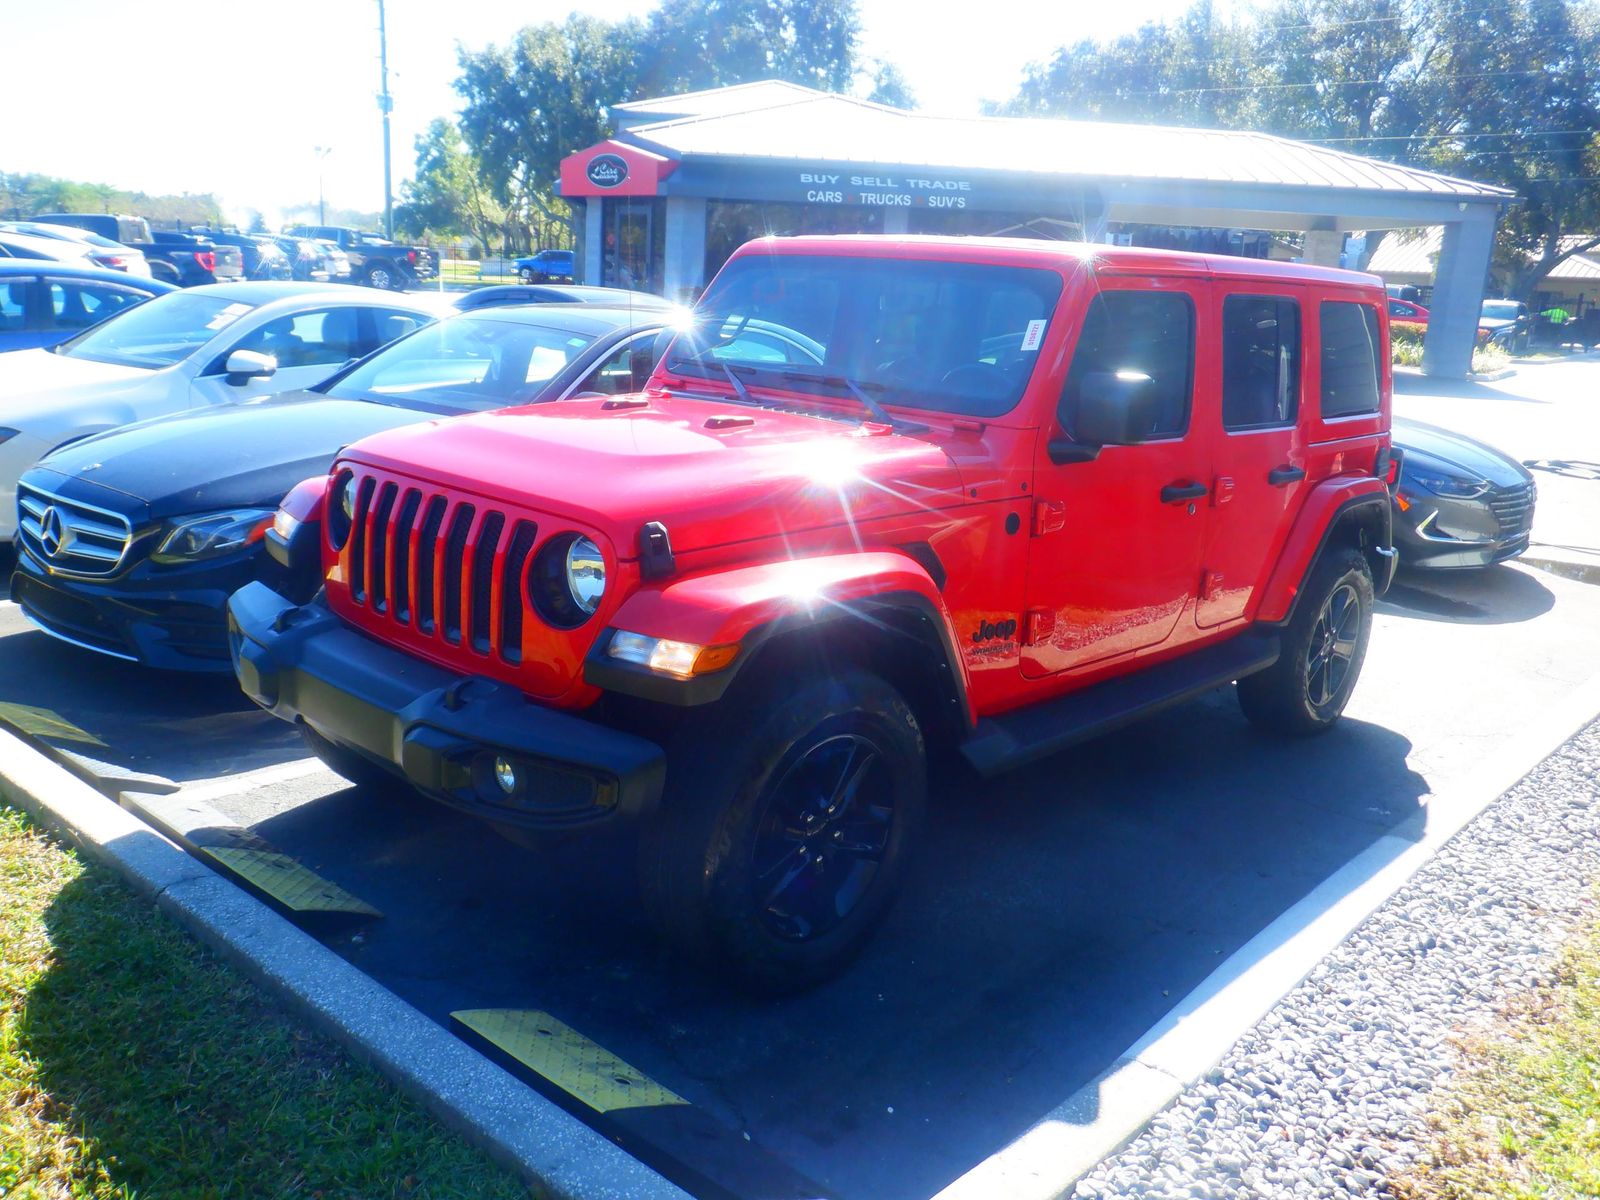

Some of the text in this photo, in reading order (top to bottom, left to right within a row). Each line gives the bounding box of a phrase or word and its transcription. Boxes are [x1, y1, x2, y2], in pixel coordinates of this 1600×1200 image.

[800, 173, 972, 191] BUY SELL TRADE
[807, 190, 966, 208] CARS TRUCKS SUV'S
[972, 618, 1017, 643] Jeep
